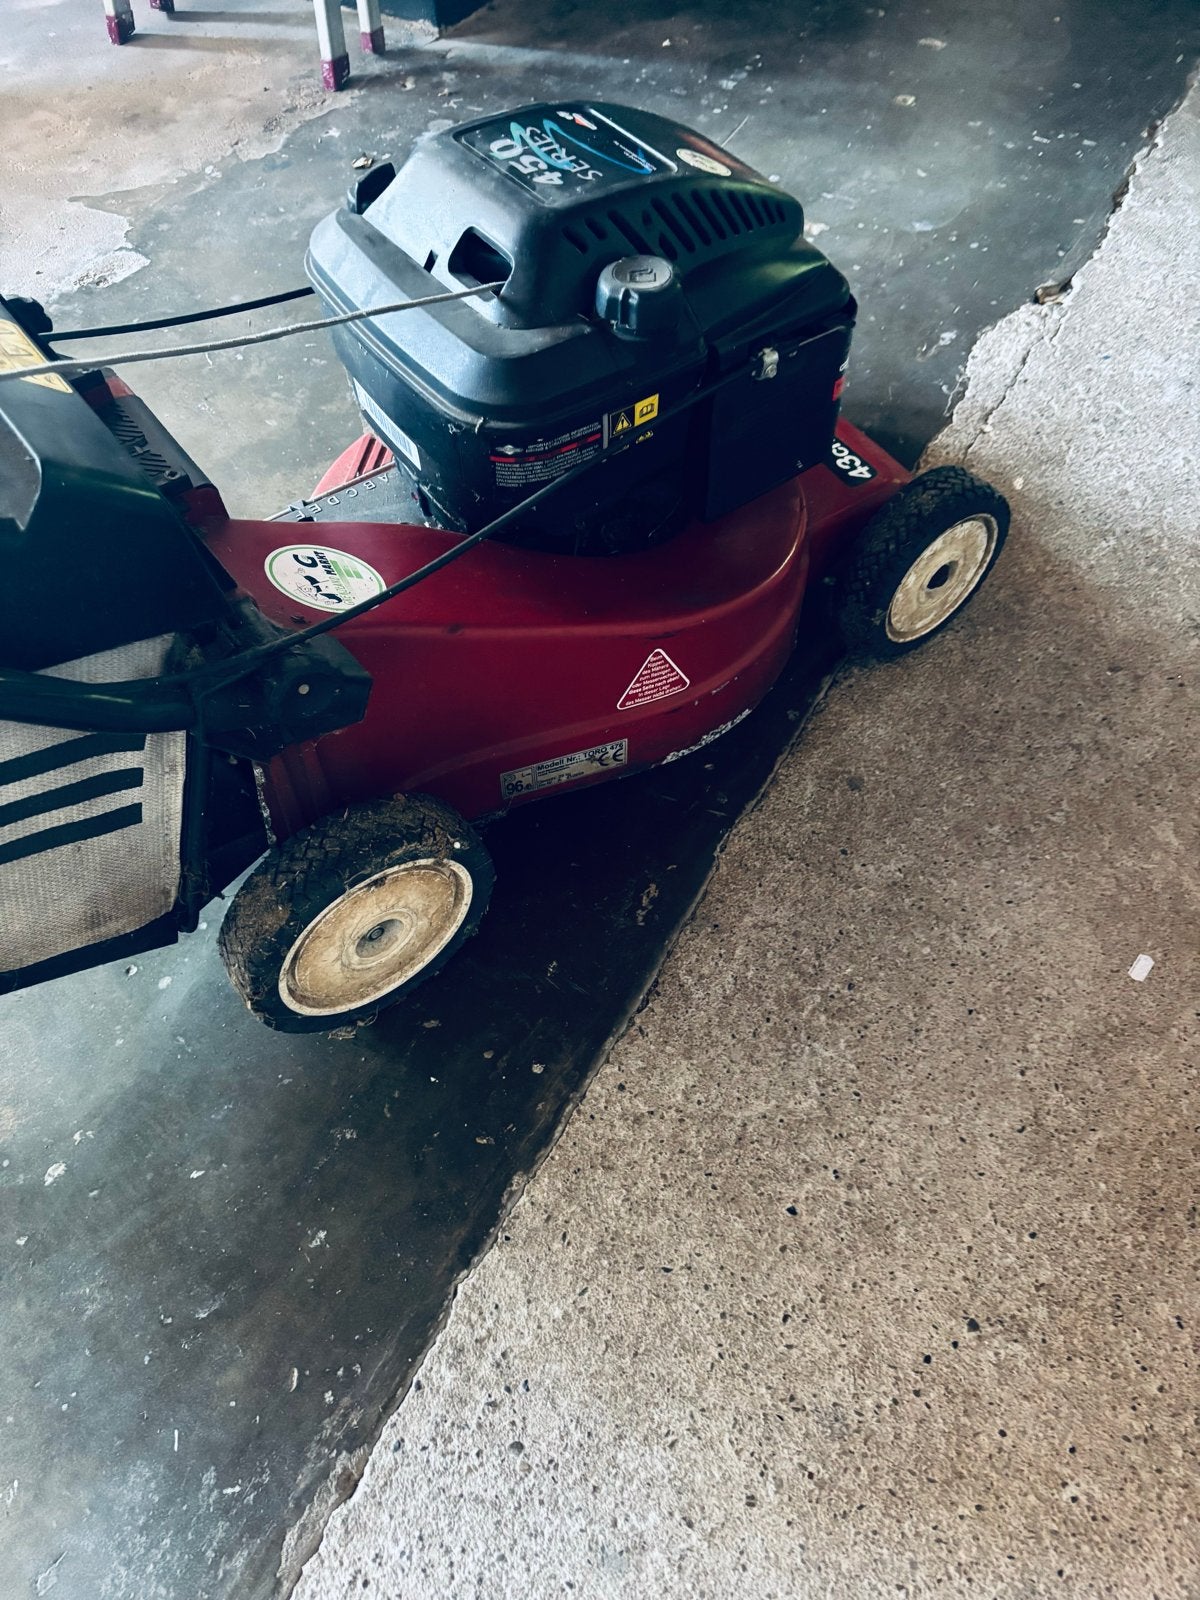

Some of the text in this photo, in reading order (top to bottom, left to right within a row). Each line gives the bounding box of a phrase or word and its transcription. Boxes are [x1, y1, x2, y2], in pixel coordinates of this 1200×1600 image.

[490, 139, 564, 185] 450
[525, 126, 603, 181] SERIES
[364, 481, 377, 490] B
[327, 497, 341, 506] D
[313, 551, 337, 576] MARKT
[537, 759, 564, 771] Modell
[583, 746, 608, 758] TORO
[506, 780, 524, 795] 96
